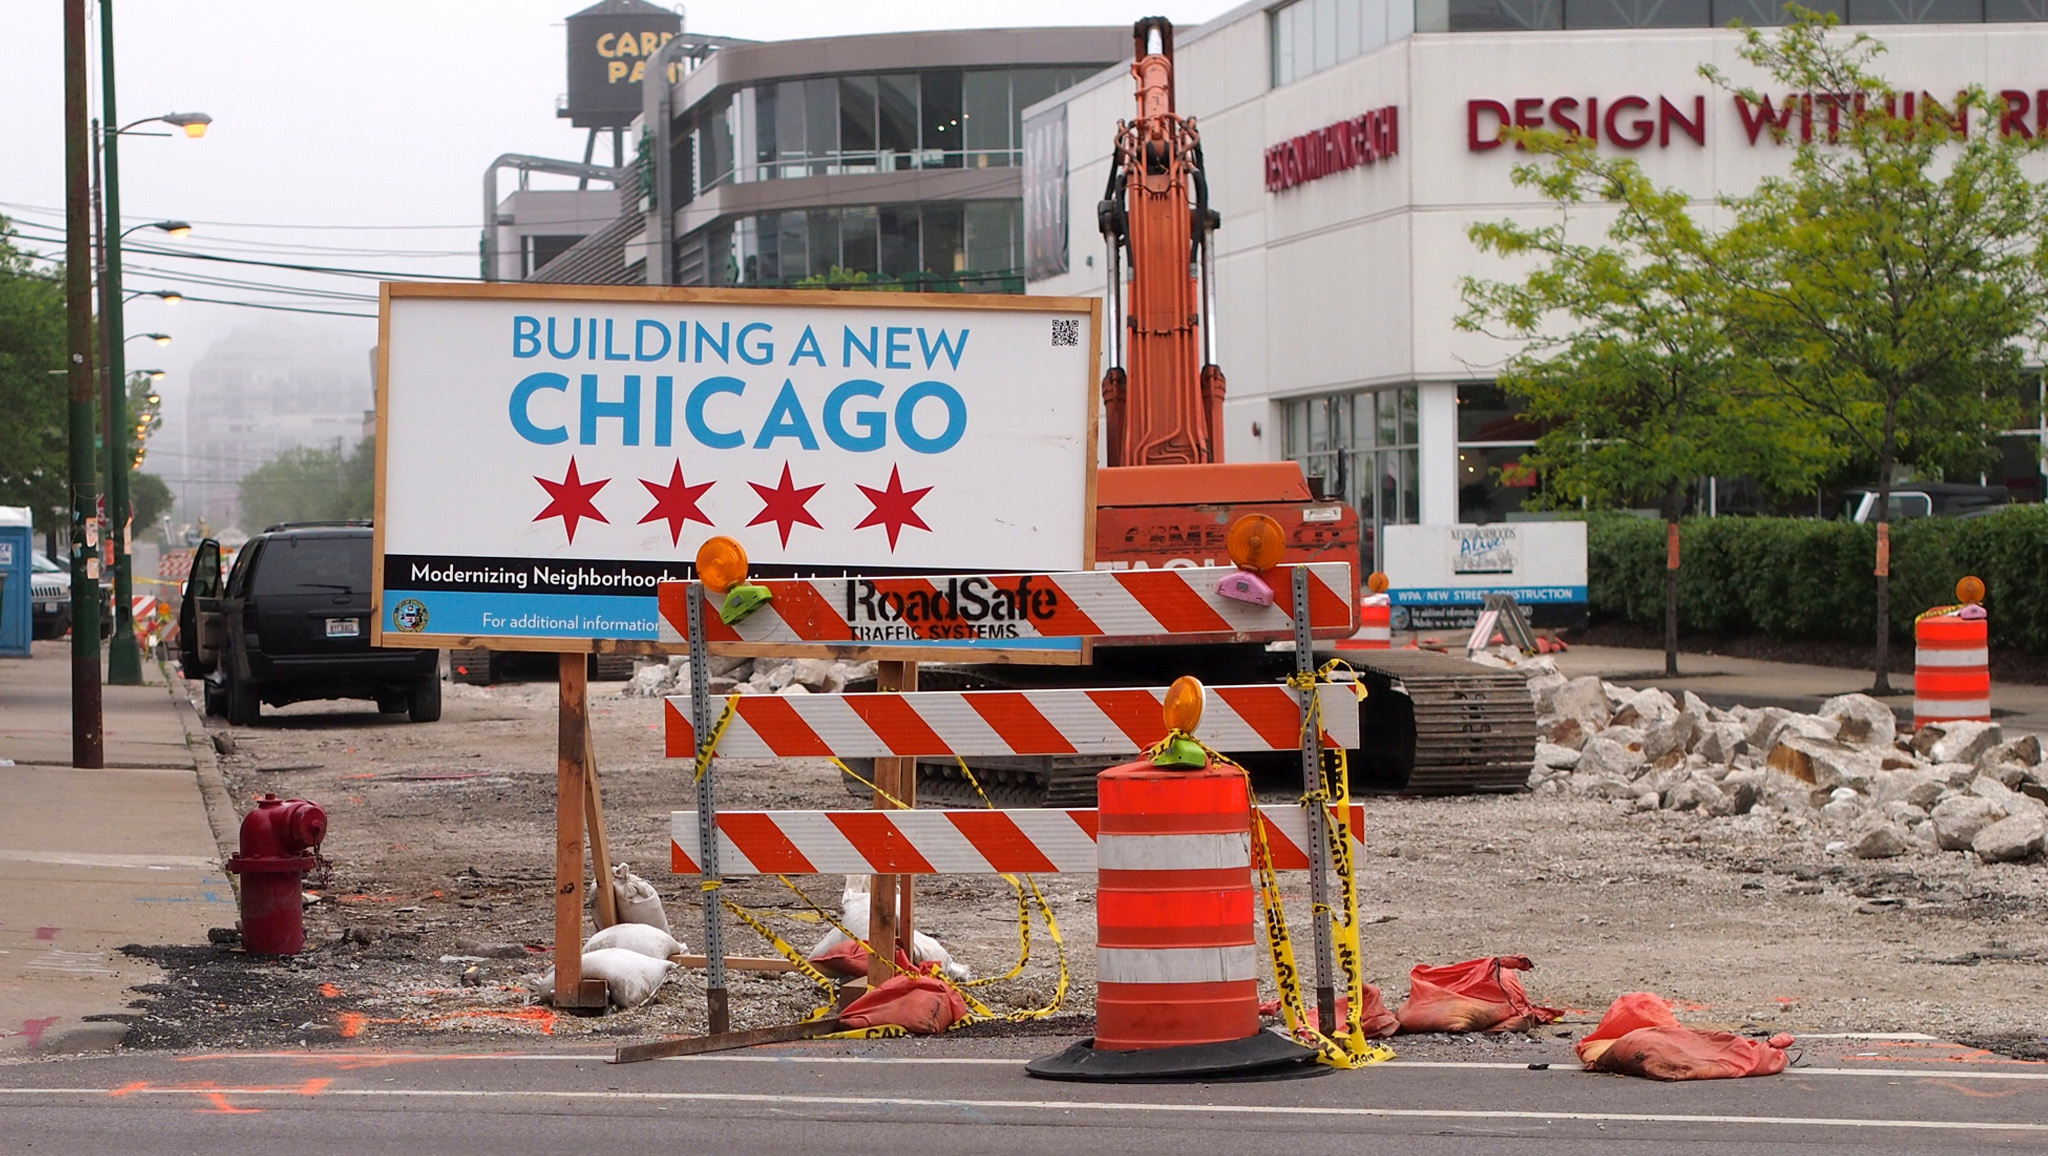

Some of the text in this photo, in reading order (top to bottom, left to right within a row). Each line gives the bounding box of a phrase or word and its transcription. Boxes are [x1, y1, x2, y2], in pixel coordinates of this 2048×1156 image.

[1468, 94, 1705, 152] DESIGN
[1733, 89, 1968, 147] WITHIN
[513, 315, 970, 372] BUILDING A NEW
[508, 371, 968, 454] CHICAGO
[410, 562, 528, 589] Modernizing
[847, 576, 1058, 622] RoadSafe
[1398, 591, 1421, 601] WPA
[1427, 590, 1449, 600] NEW
[483, 612, 505, 629] For
[510, 612, 578, 630] additional
[849, 623, 1019, 641] TRAFFIC SYSTEMS
